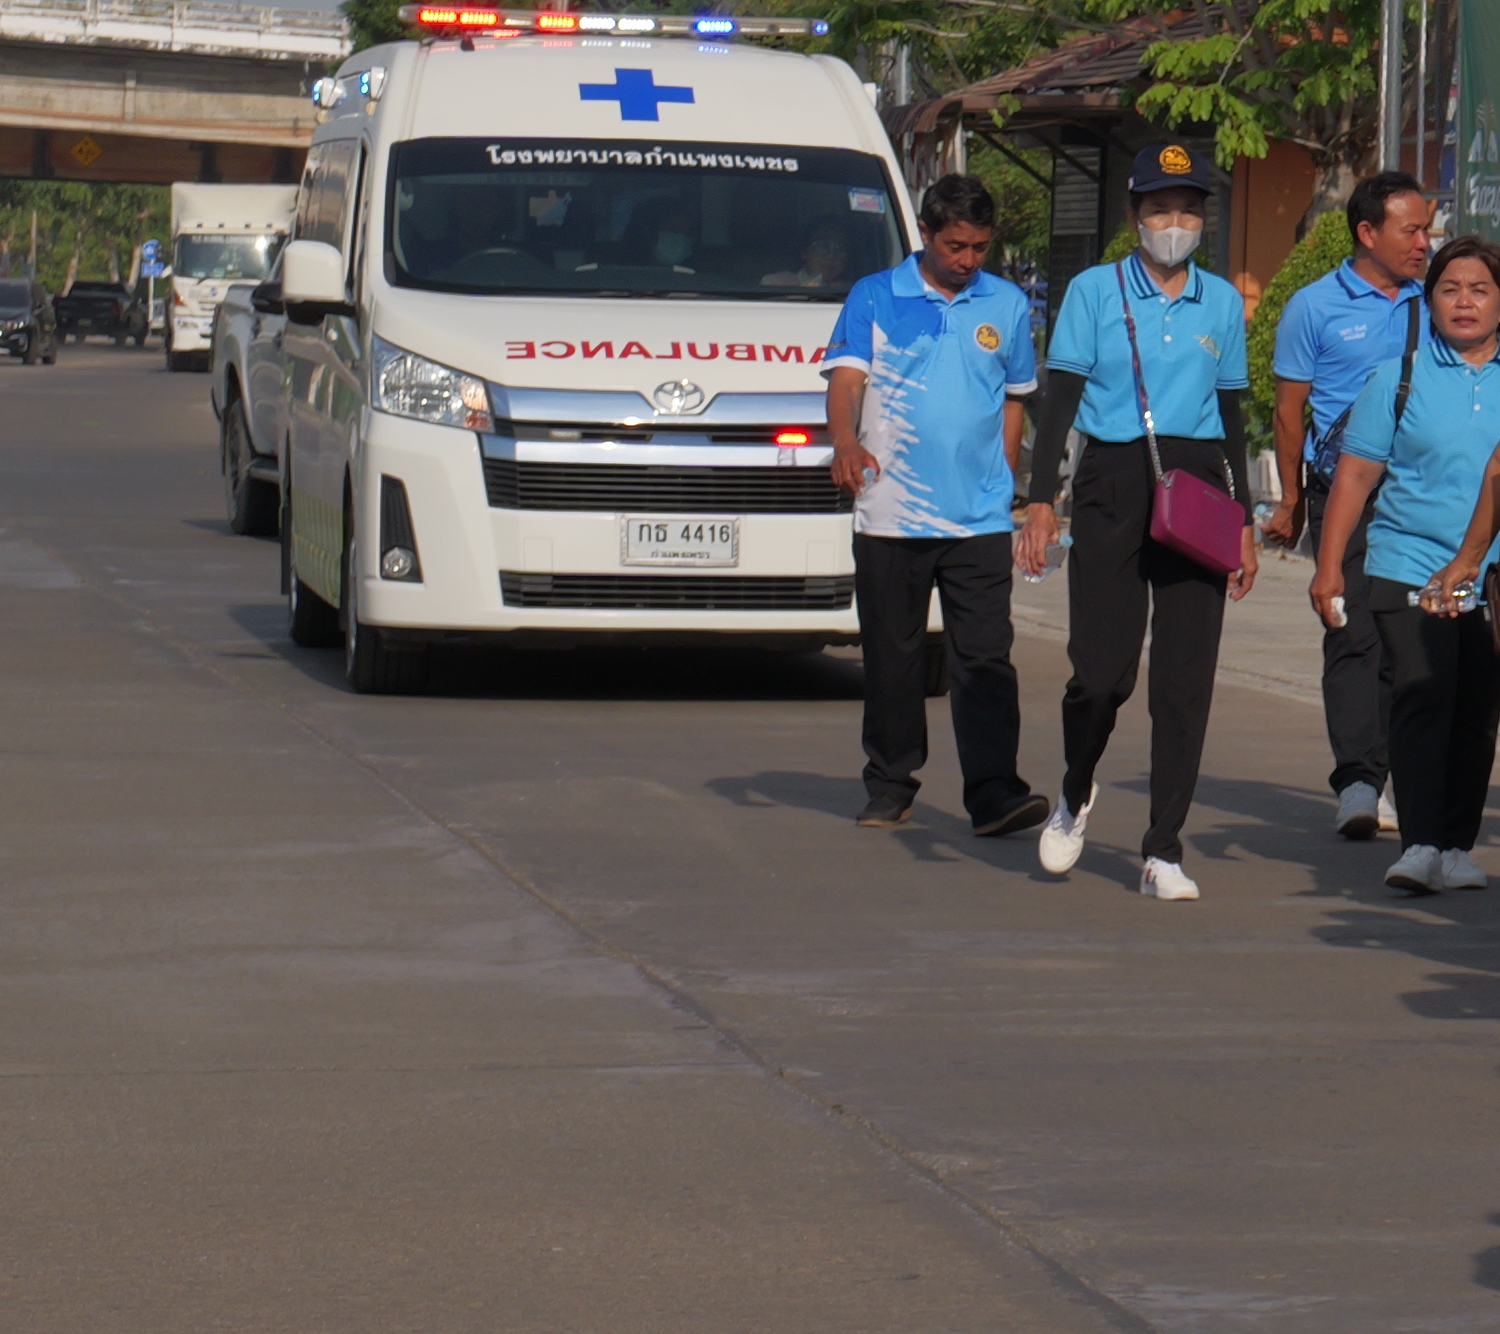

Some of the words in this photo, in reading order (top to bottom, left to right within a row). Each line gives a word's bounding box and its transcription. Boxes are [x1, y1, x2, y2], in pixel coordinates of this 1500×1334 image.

[485, 144, 800, 173] โรงพยาบาลกำแพงเพชร
[638, 522, 668, 545] กธ
[681, 522, 731, 545] 4416
